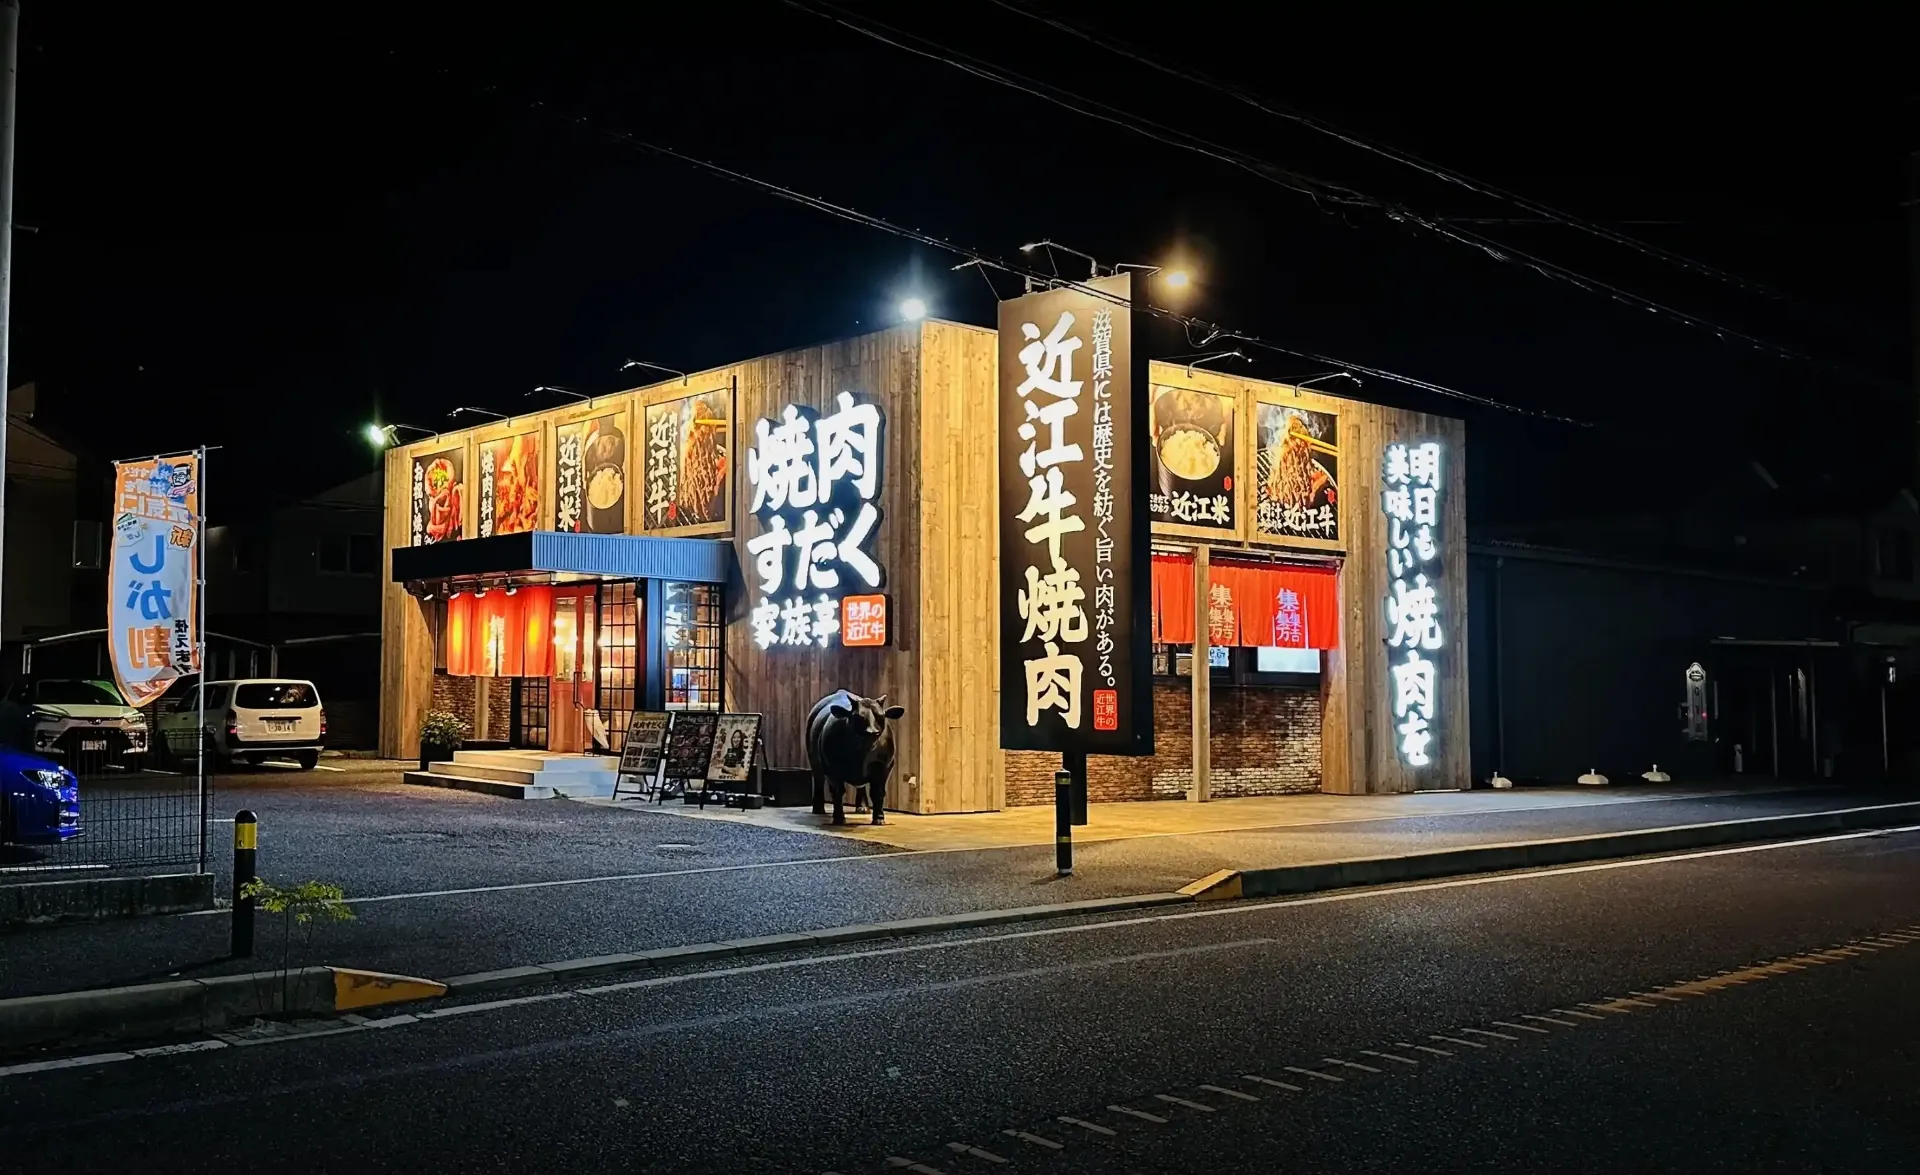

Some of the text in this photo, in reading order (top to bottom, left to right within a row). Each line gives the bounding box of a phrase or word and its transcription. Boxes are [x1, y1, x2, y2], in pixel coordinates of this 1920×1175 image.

[558, 433, 577, 532] 近江米
[648, 412, 670, 525] 近江牛
[748, 390, 881, 514] 焼肉
[1092, 307, 1116, 687] 滋賀県には歴史を紡ぐ旨い肉がある。
[747, 503, 881, 594] すだく
[1016, 311, 1090, 730] 近江牛焼肉
[1171, 491, 1230, 525] 近江米
[1283, 503, 1337, 537] 近江牛
[1382, 444, 1414, 580] 美味しい
[1409, 443, 1441, 561] 明日も
[750, 593, 840, 650] 家族亭
[846, 600, 884, 623] 世界の
[846, 621, 885, 641] 近江牛
[1096, 693, 1106, 727] 近江牛
[1105, 693, 1115, 726] 世界の
[1386, 573, 1443, 766] 焼肉を
